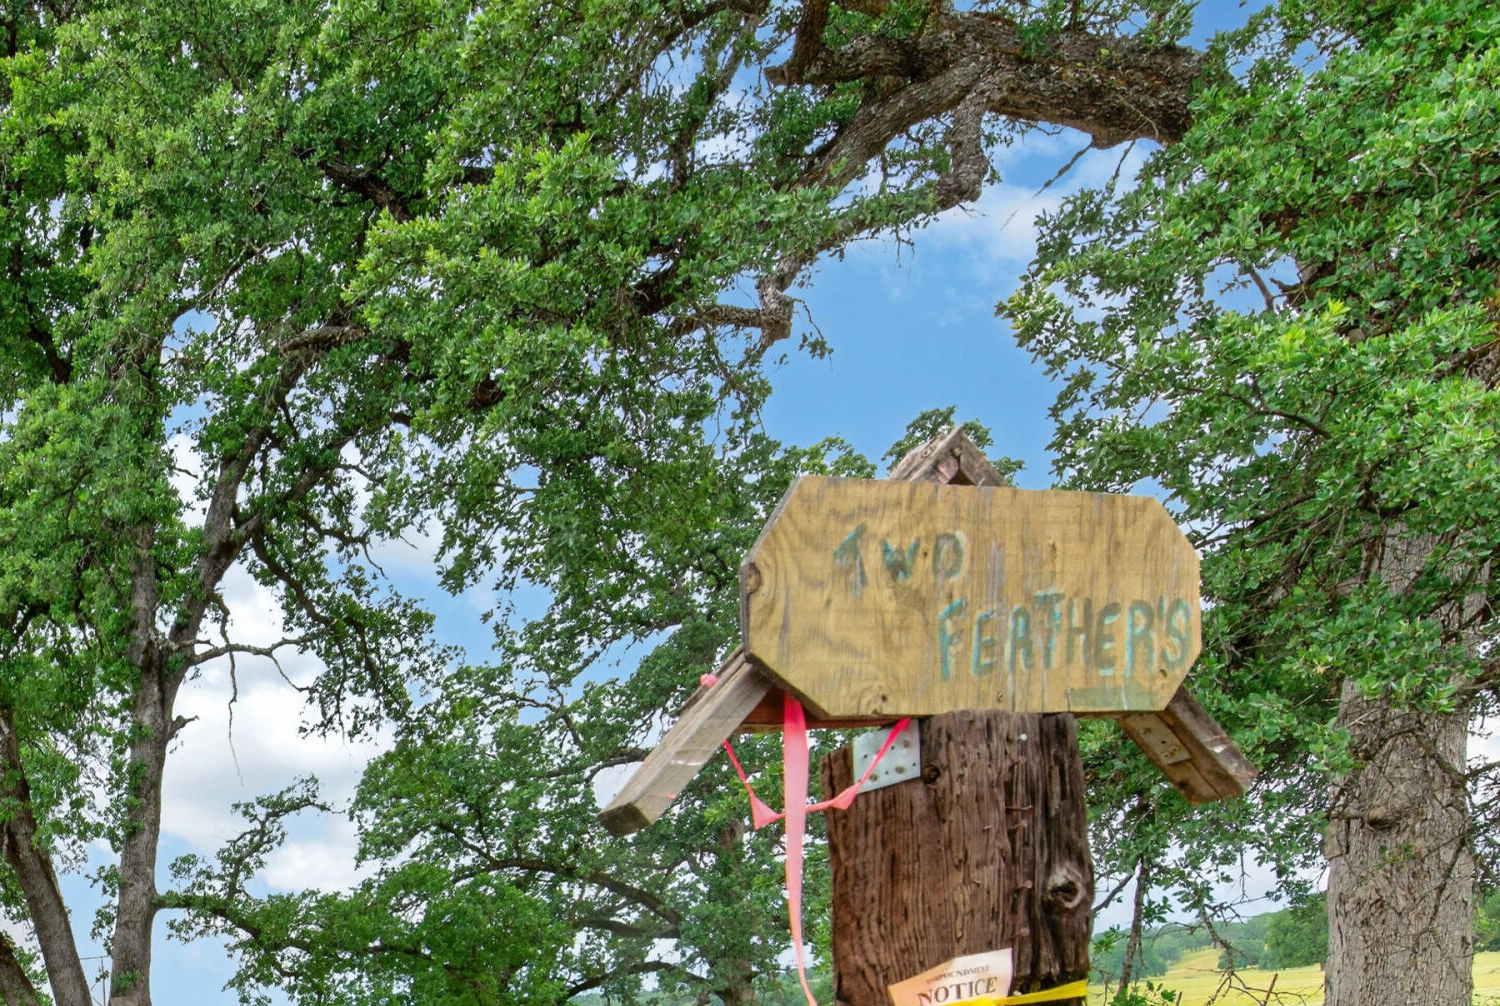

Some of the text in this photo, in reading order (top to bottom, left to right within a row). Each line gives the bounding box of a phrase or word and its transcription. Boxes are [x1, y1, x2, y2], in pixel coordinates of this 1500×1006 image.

[834, 521, 969, 597] TWO
[938, 587, 1193, 682] FEATHER'S
[916, 976, 998, 1006] NOTICE
